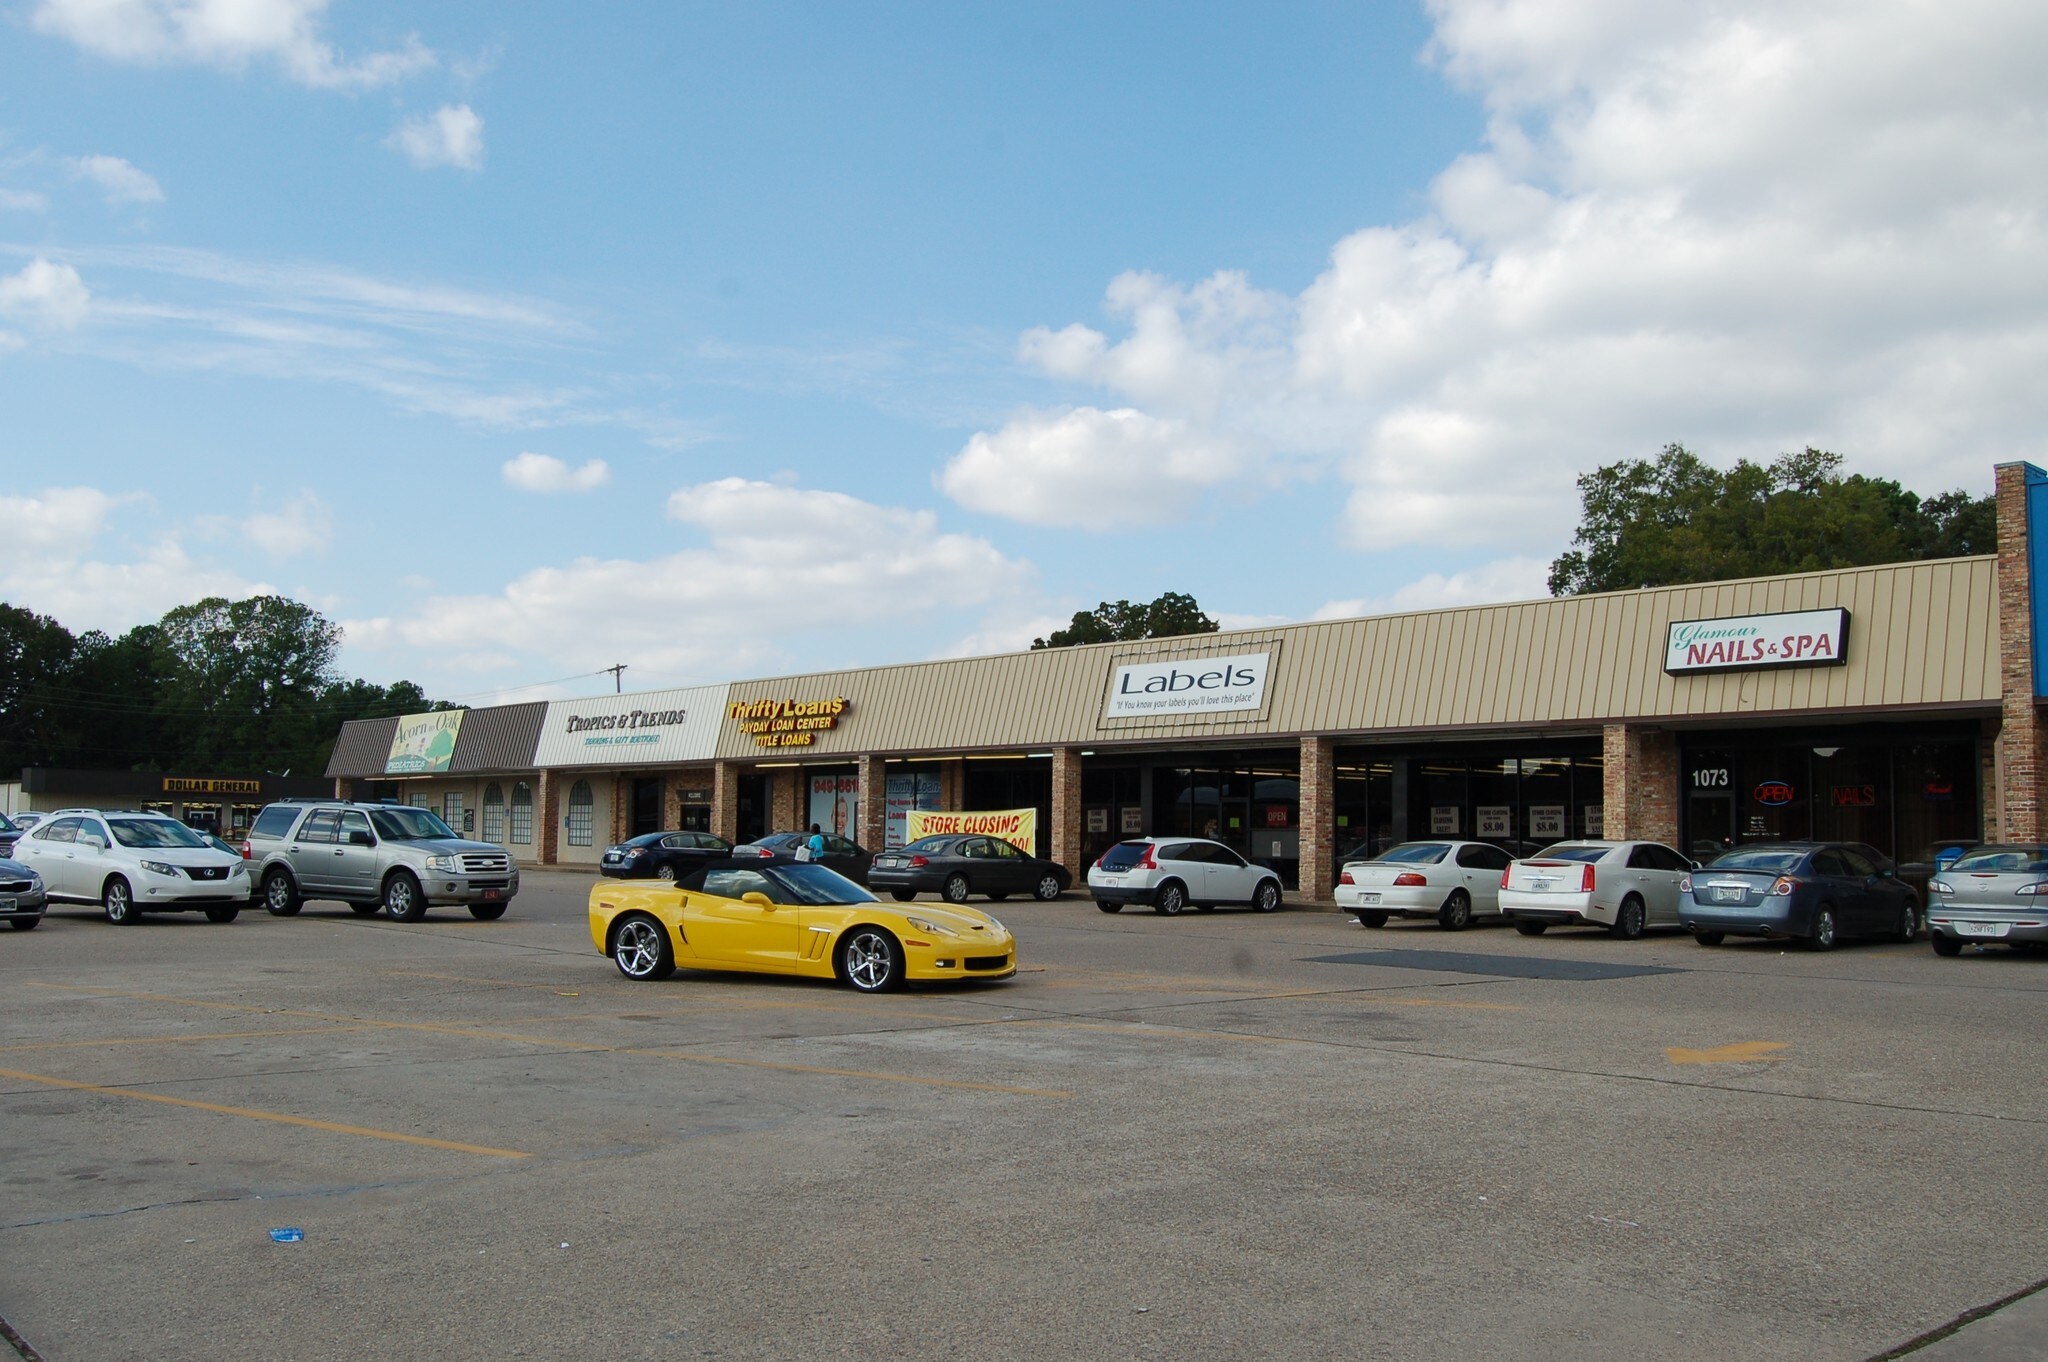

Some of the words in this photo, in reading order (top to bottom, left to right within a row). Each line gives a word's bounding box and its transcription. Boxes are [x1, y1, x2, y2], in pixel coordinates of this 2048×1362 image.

[1674, 625, 1760, 649] Glamour
[1687, 638, 1764, 665] NAILS
[1767, 643, 1777, 655] &
[1781, 633, 1832, 658] SPA
[1121, 665, 1255, 694] Labels
[728, 700, 781, 719] Thrifty
[1124, 700, 1135, 709] You
[1136, 700, 1152, 709] know
[1153, 701, 1167, 710] your
[1168, 698, 1186, 707] labels
[1188, 697, 1205, 708] you'll
[1206, 696, 1220, 705] love
[1221, 694, 1233, 704] this
[395, 723, 427, 743] Acorn
[436, 712, 459, 731] Oak
[617, 714, 629, 729] &
[739, 721, 770, 734] PAYDAY
[771, 719, 794, 732] LOAN
[796, 717, 831, 730] CENTER
[755, 735, 778, 747] TITLE
[780, 734, 811, 746] LOANS
[1692, 769, 1728, 786] 1073
[168, 780, 208, 790] DOLLAR
[212, 781, 258, 792] GENERAL
[888, 780, 914, 796] Thrifty
[1754, 786, 1794, 800] OPEN
[1833, 786, 1873, 804] NAILS
[1267, 811, 1287, 821] OPEN
[922, 816, 961, 834] STORE
[964, 815, 1020, 834] CLOSING
[1483, 822, 1504, 832] $8.00
[1536, 822, 1558, 832] $8.00
